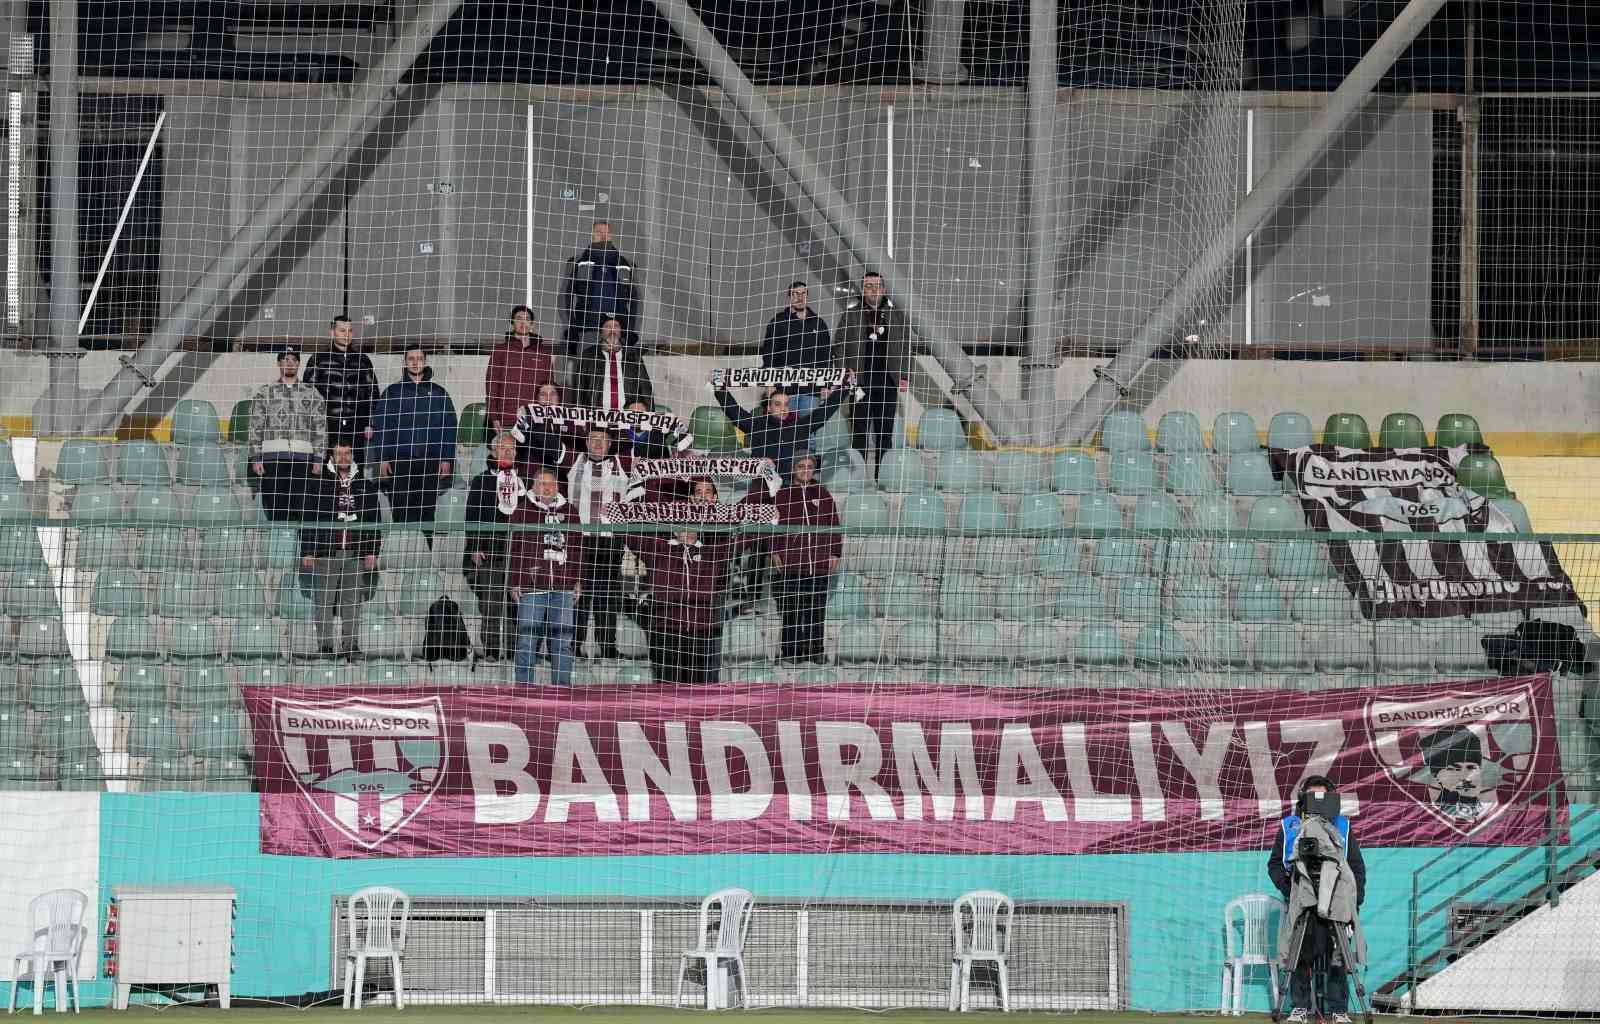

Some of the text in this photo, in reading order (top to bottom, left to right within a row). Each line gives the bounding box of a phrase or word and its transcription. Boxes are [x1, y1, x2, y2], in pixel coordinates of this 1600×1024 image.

[734, 369, 842, 382] BANDIRMASPOR
[533, 404, 673, 430] BANDIRMASPOR
[1400, 503, 1441, 516] 1965
[1378, 702, 1521, 723] BANDIRMASPOR
[288, 717, 430, 731] BANDIRMASPOR
[464, 719, 1360, 823] BANDIRMALIYIZ
